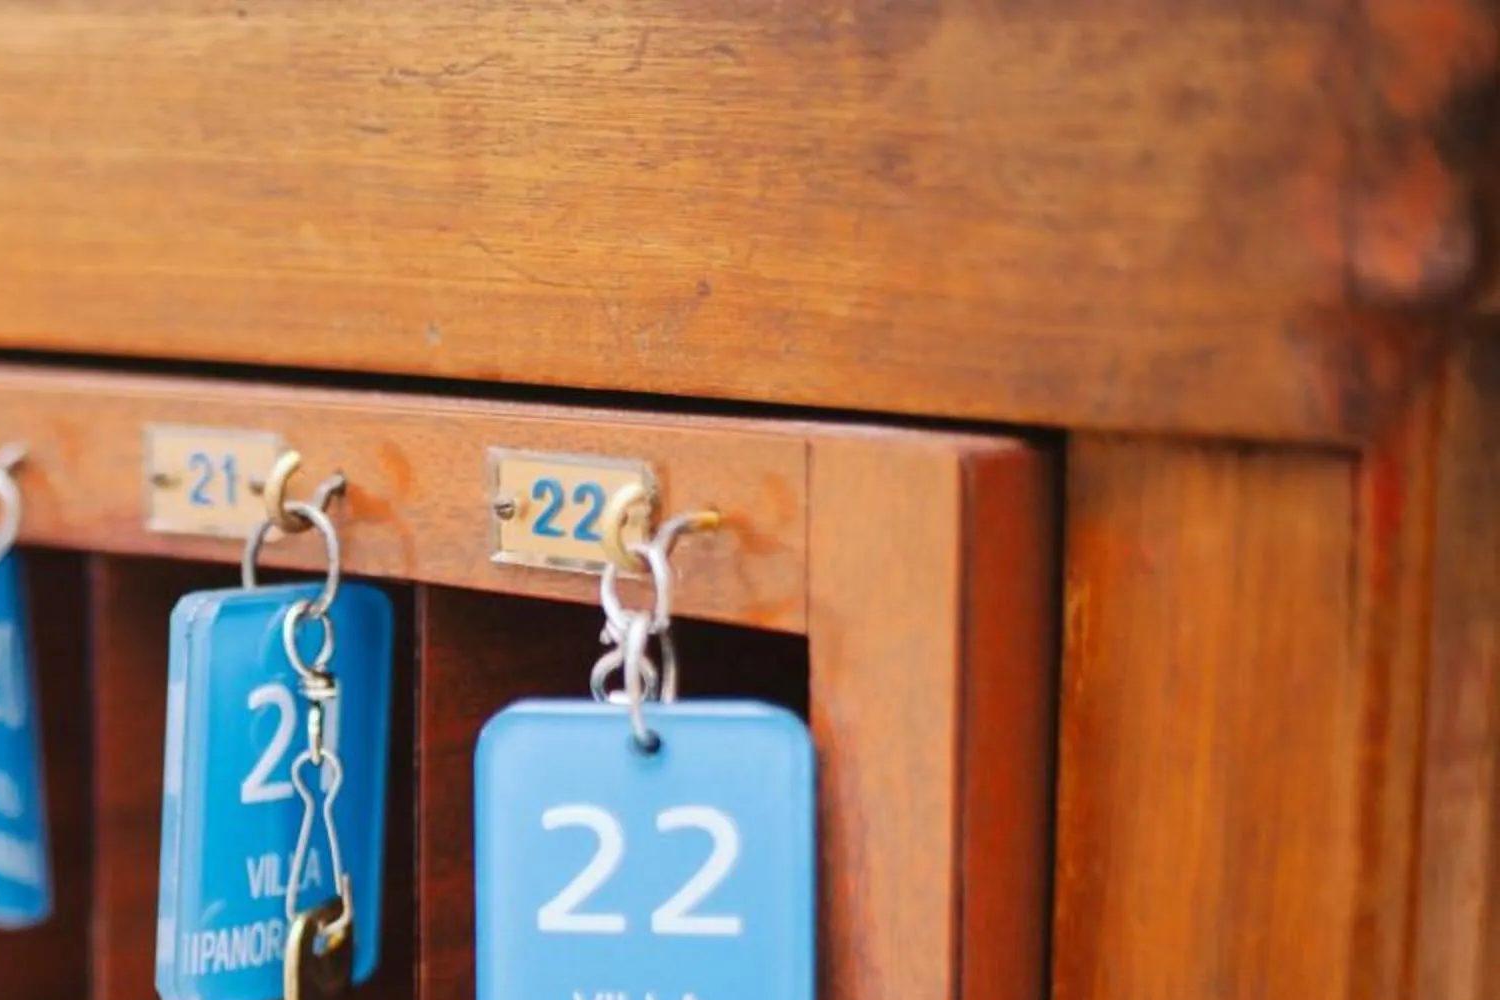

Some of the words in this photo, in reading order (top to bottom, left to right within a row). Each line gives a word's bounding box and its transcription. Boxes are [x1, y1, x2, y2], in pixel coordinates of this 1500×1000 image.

[188, 451, 238, 506] 21
[531, 477, 607, 542] 22
[536, 803, 743, 937] 22
